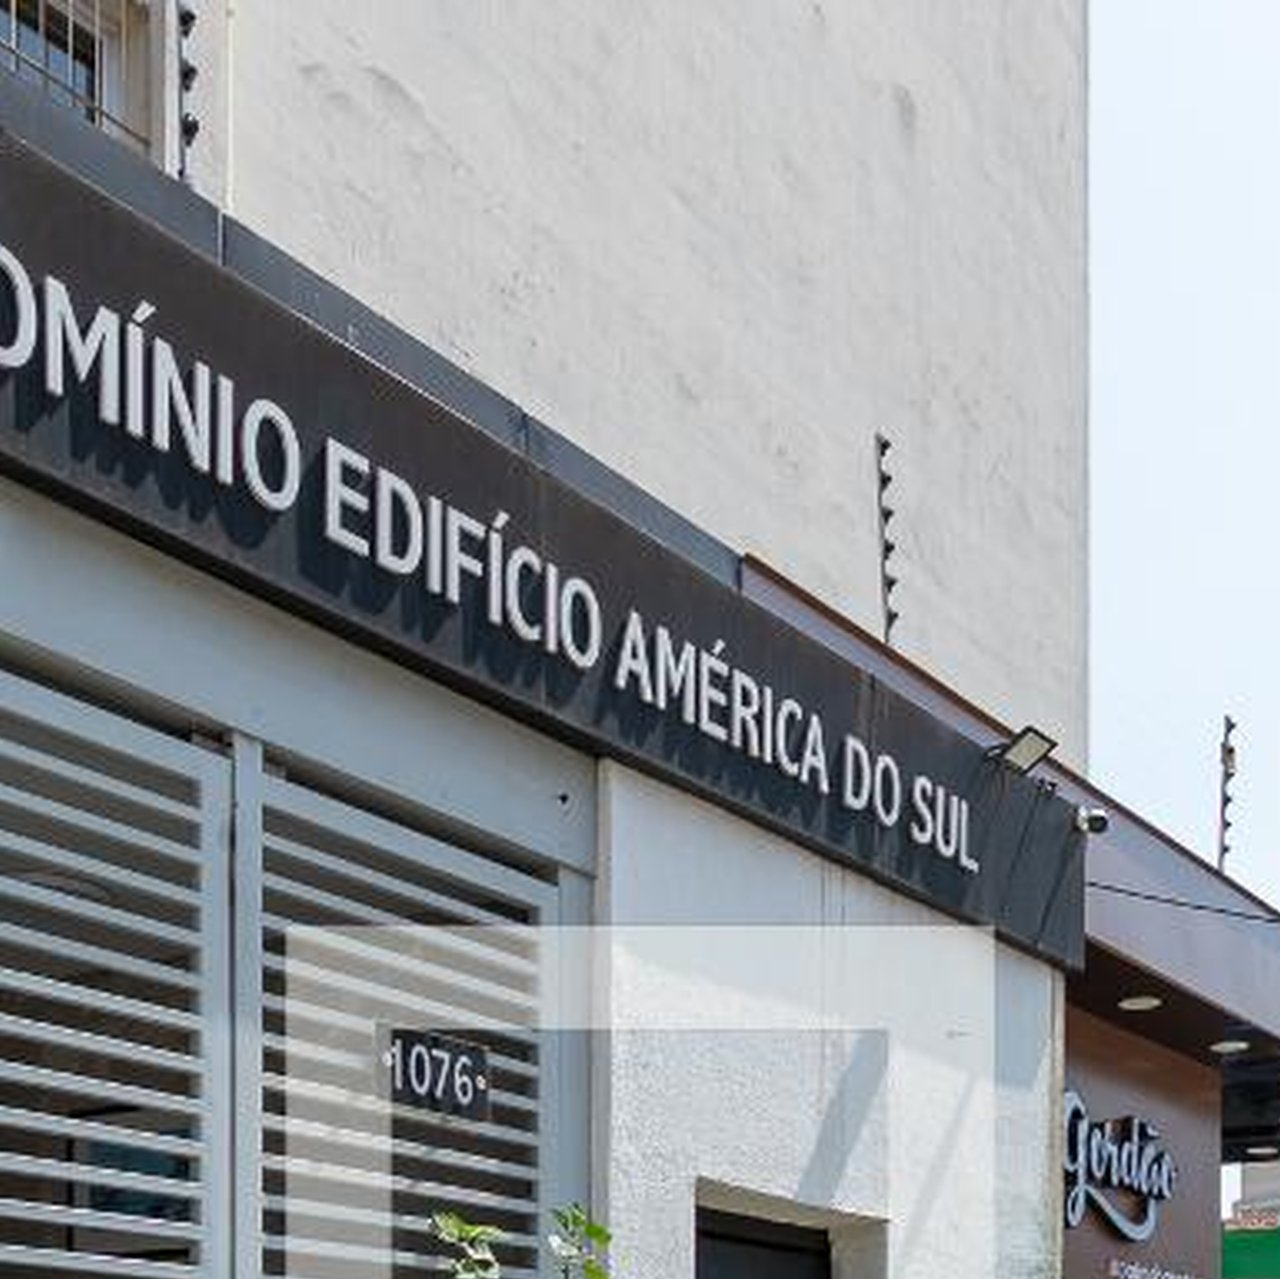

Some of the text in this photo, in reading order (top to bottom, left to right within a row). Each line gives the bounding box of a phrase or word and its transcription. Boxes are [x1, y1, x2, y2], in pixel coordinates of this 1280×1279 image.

[325, 436, 601, 669] EDIFÍCIO
[615, 609, 829, 794] AMÉRICA
[844, 734, 901, 828] DO
[911, 776, 979, 874] SUL
[390, 1038, 475, 1106] 1076
